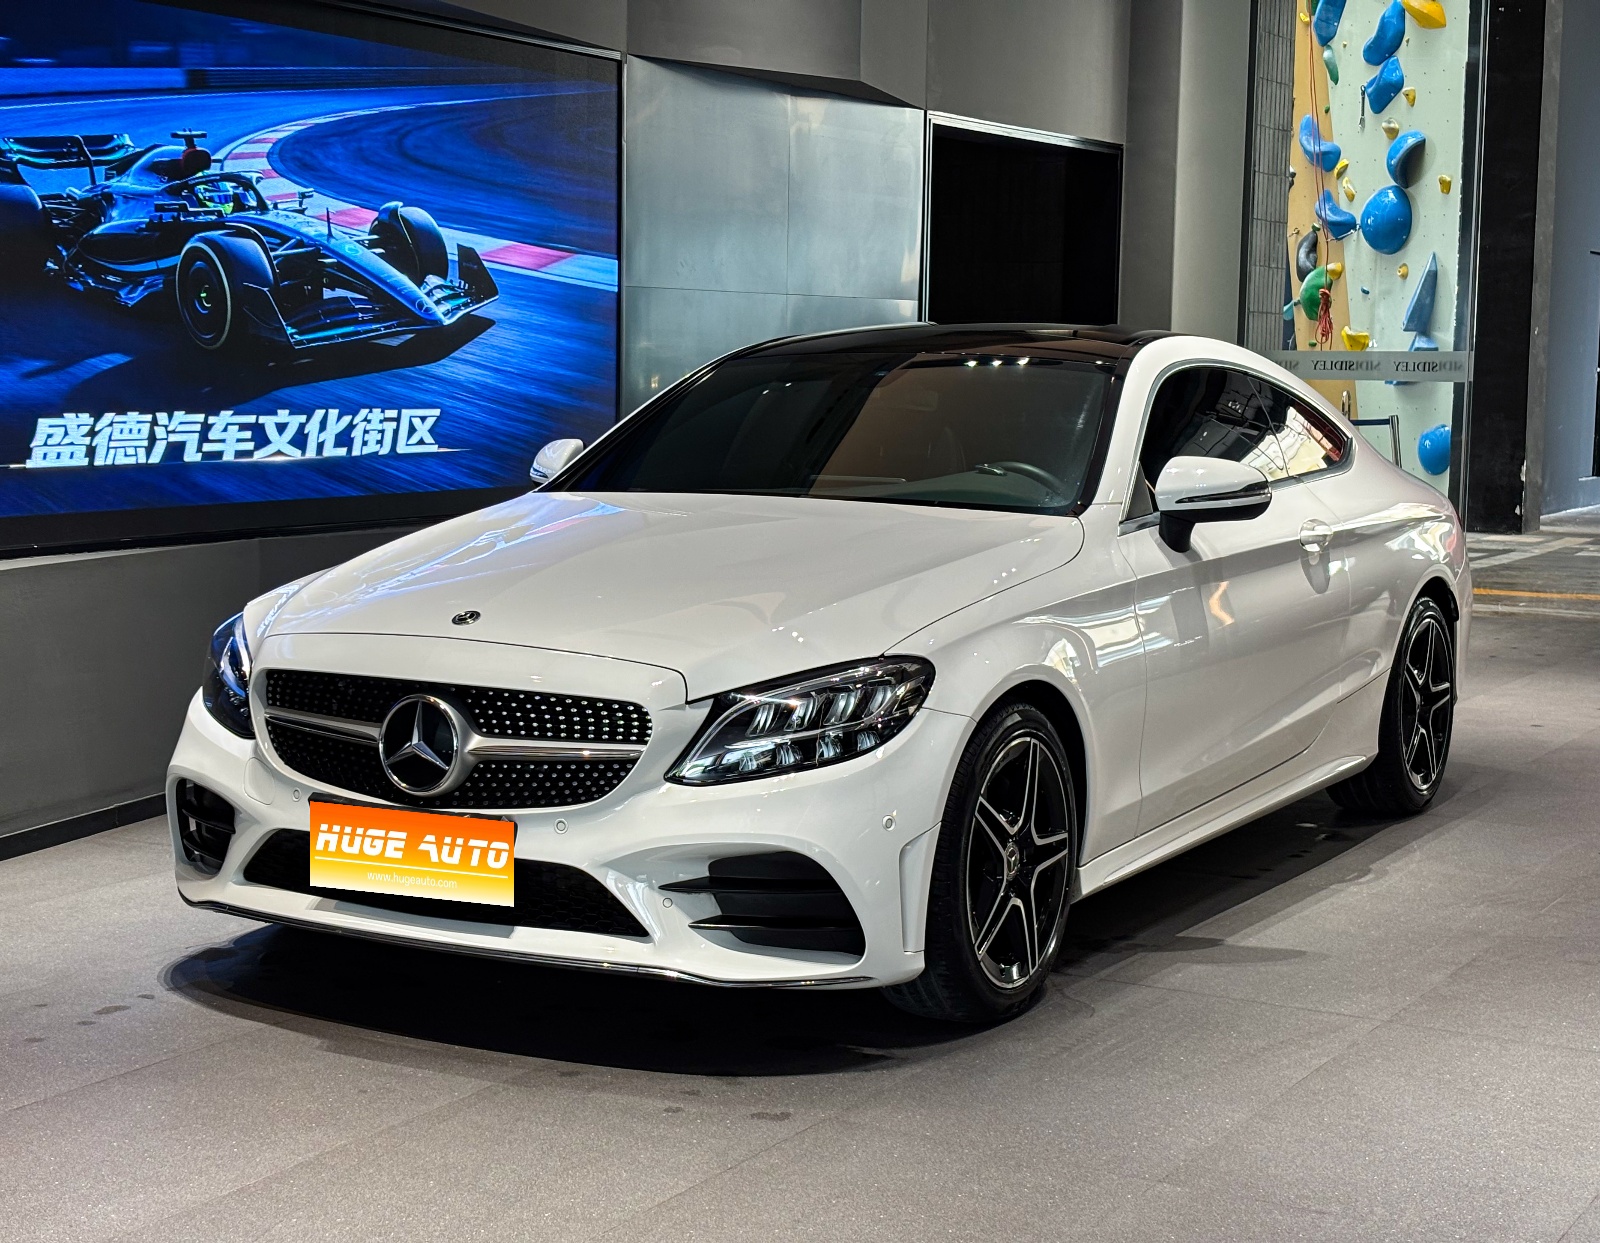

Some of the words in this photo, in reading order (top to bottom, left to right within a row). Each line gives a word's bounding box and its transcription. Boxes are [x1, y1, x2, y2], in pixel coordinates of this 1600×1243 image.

[26, 408, 441, 468] 盛德汽车文化街区
